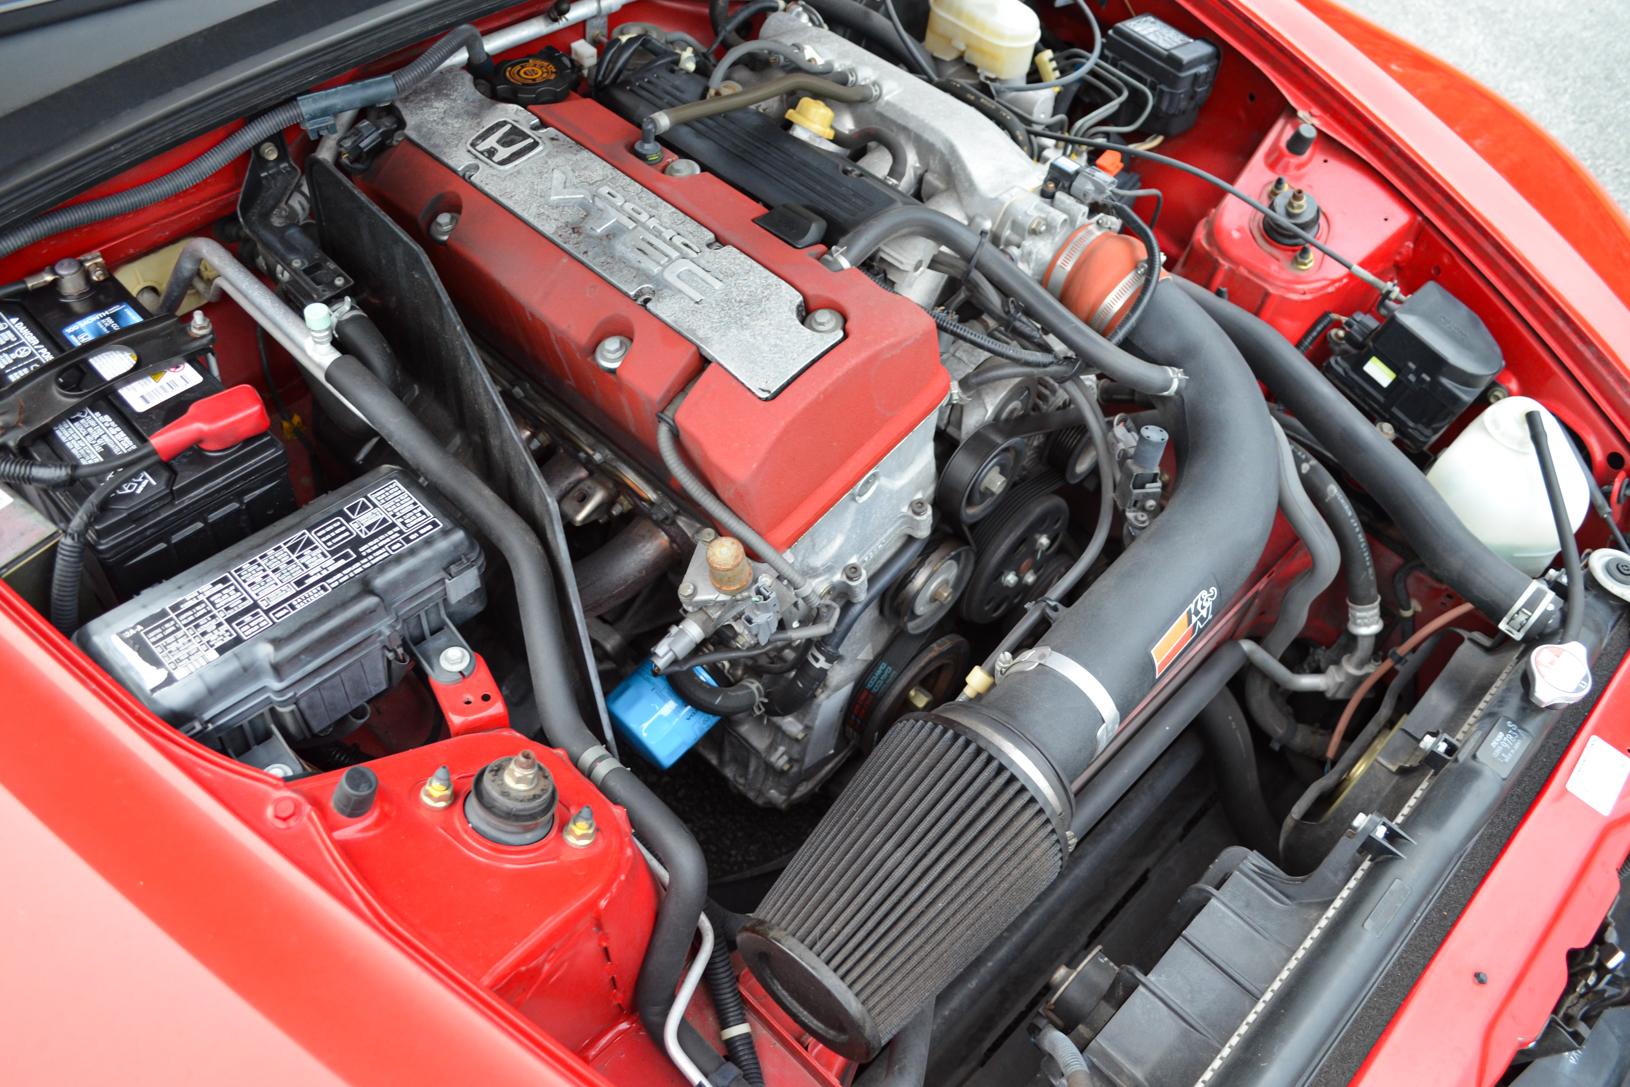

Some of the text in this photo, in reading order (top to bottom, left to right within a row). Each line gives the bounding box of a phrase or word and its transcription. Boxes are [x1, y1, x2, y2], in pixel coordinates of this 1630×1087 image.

[550, 168, 724, 303] VTEC
[597, 185, 701, 257] DOHC
[14, 320, 40, 346] DANGER
